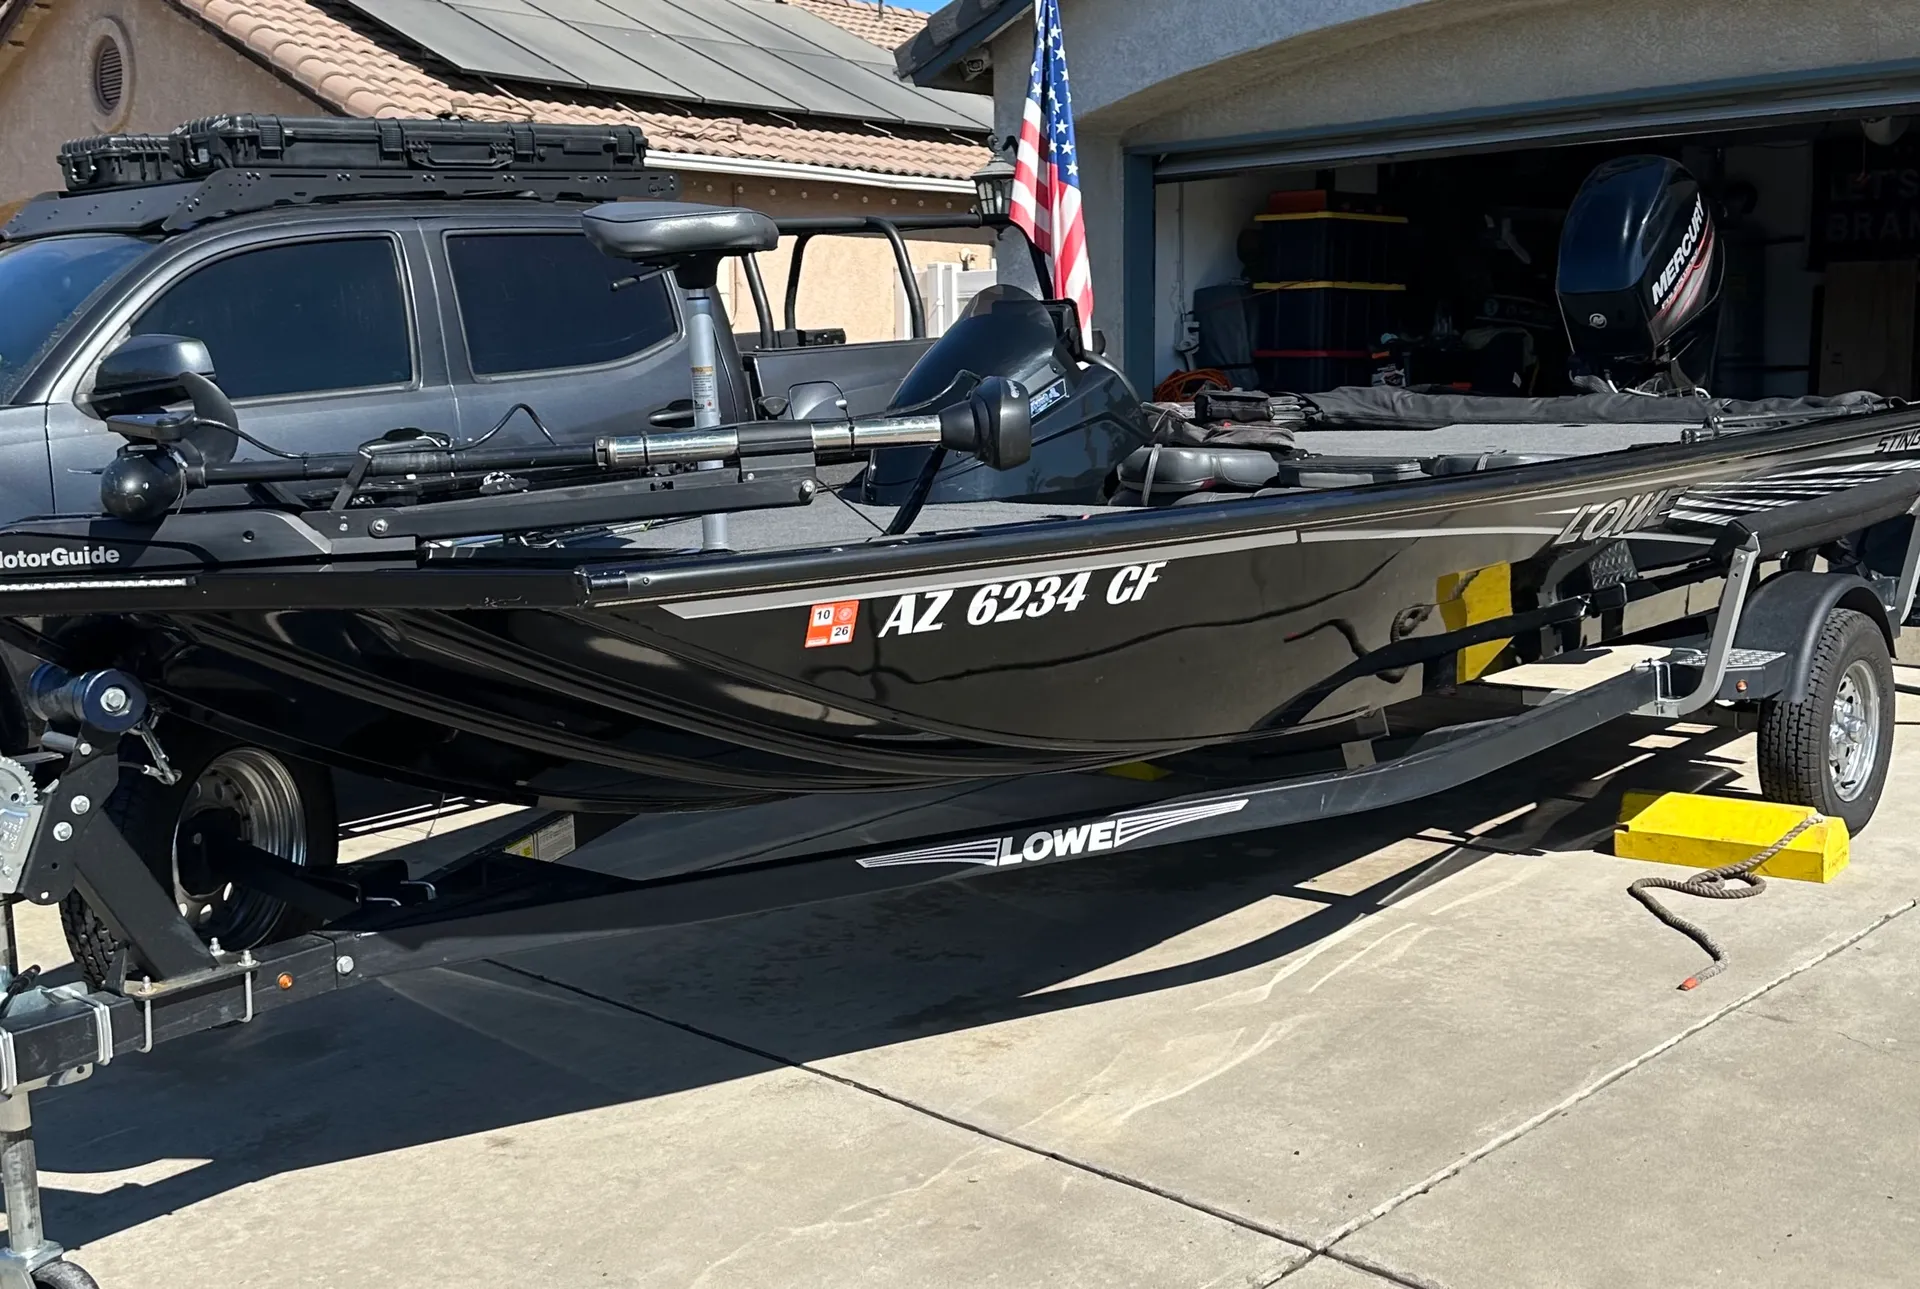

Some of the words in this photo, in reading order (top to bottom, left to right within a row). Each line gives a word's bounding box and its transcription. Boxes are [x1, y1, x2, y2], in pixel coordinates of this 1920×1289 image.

[1651, 191, 1704, 306] MERCURY
[1552, 484, 1694, 547] LOWE
[0, 545, 120, 569] otorGuide
[816, 609, 831, 621] 10
[877, 589, 955, 638] AZ
[966, 571, 1092, 627] 6234
[1105, 560, 1169, 606] CF
[833, 625, 850, 637] 26
[998, 819, 1116, 866] LOWE
